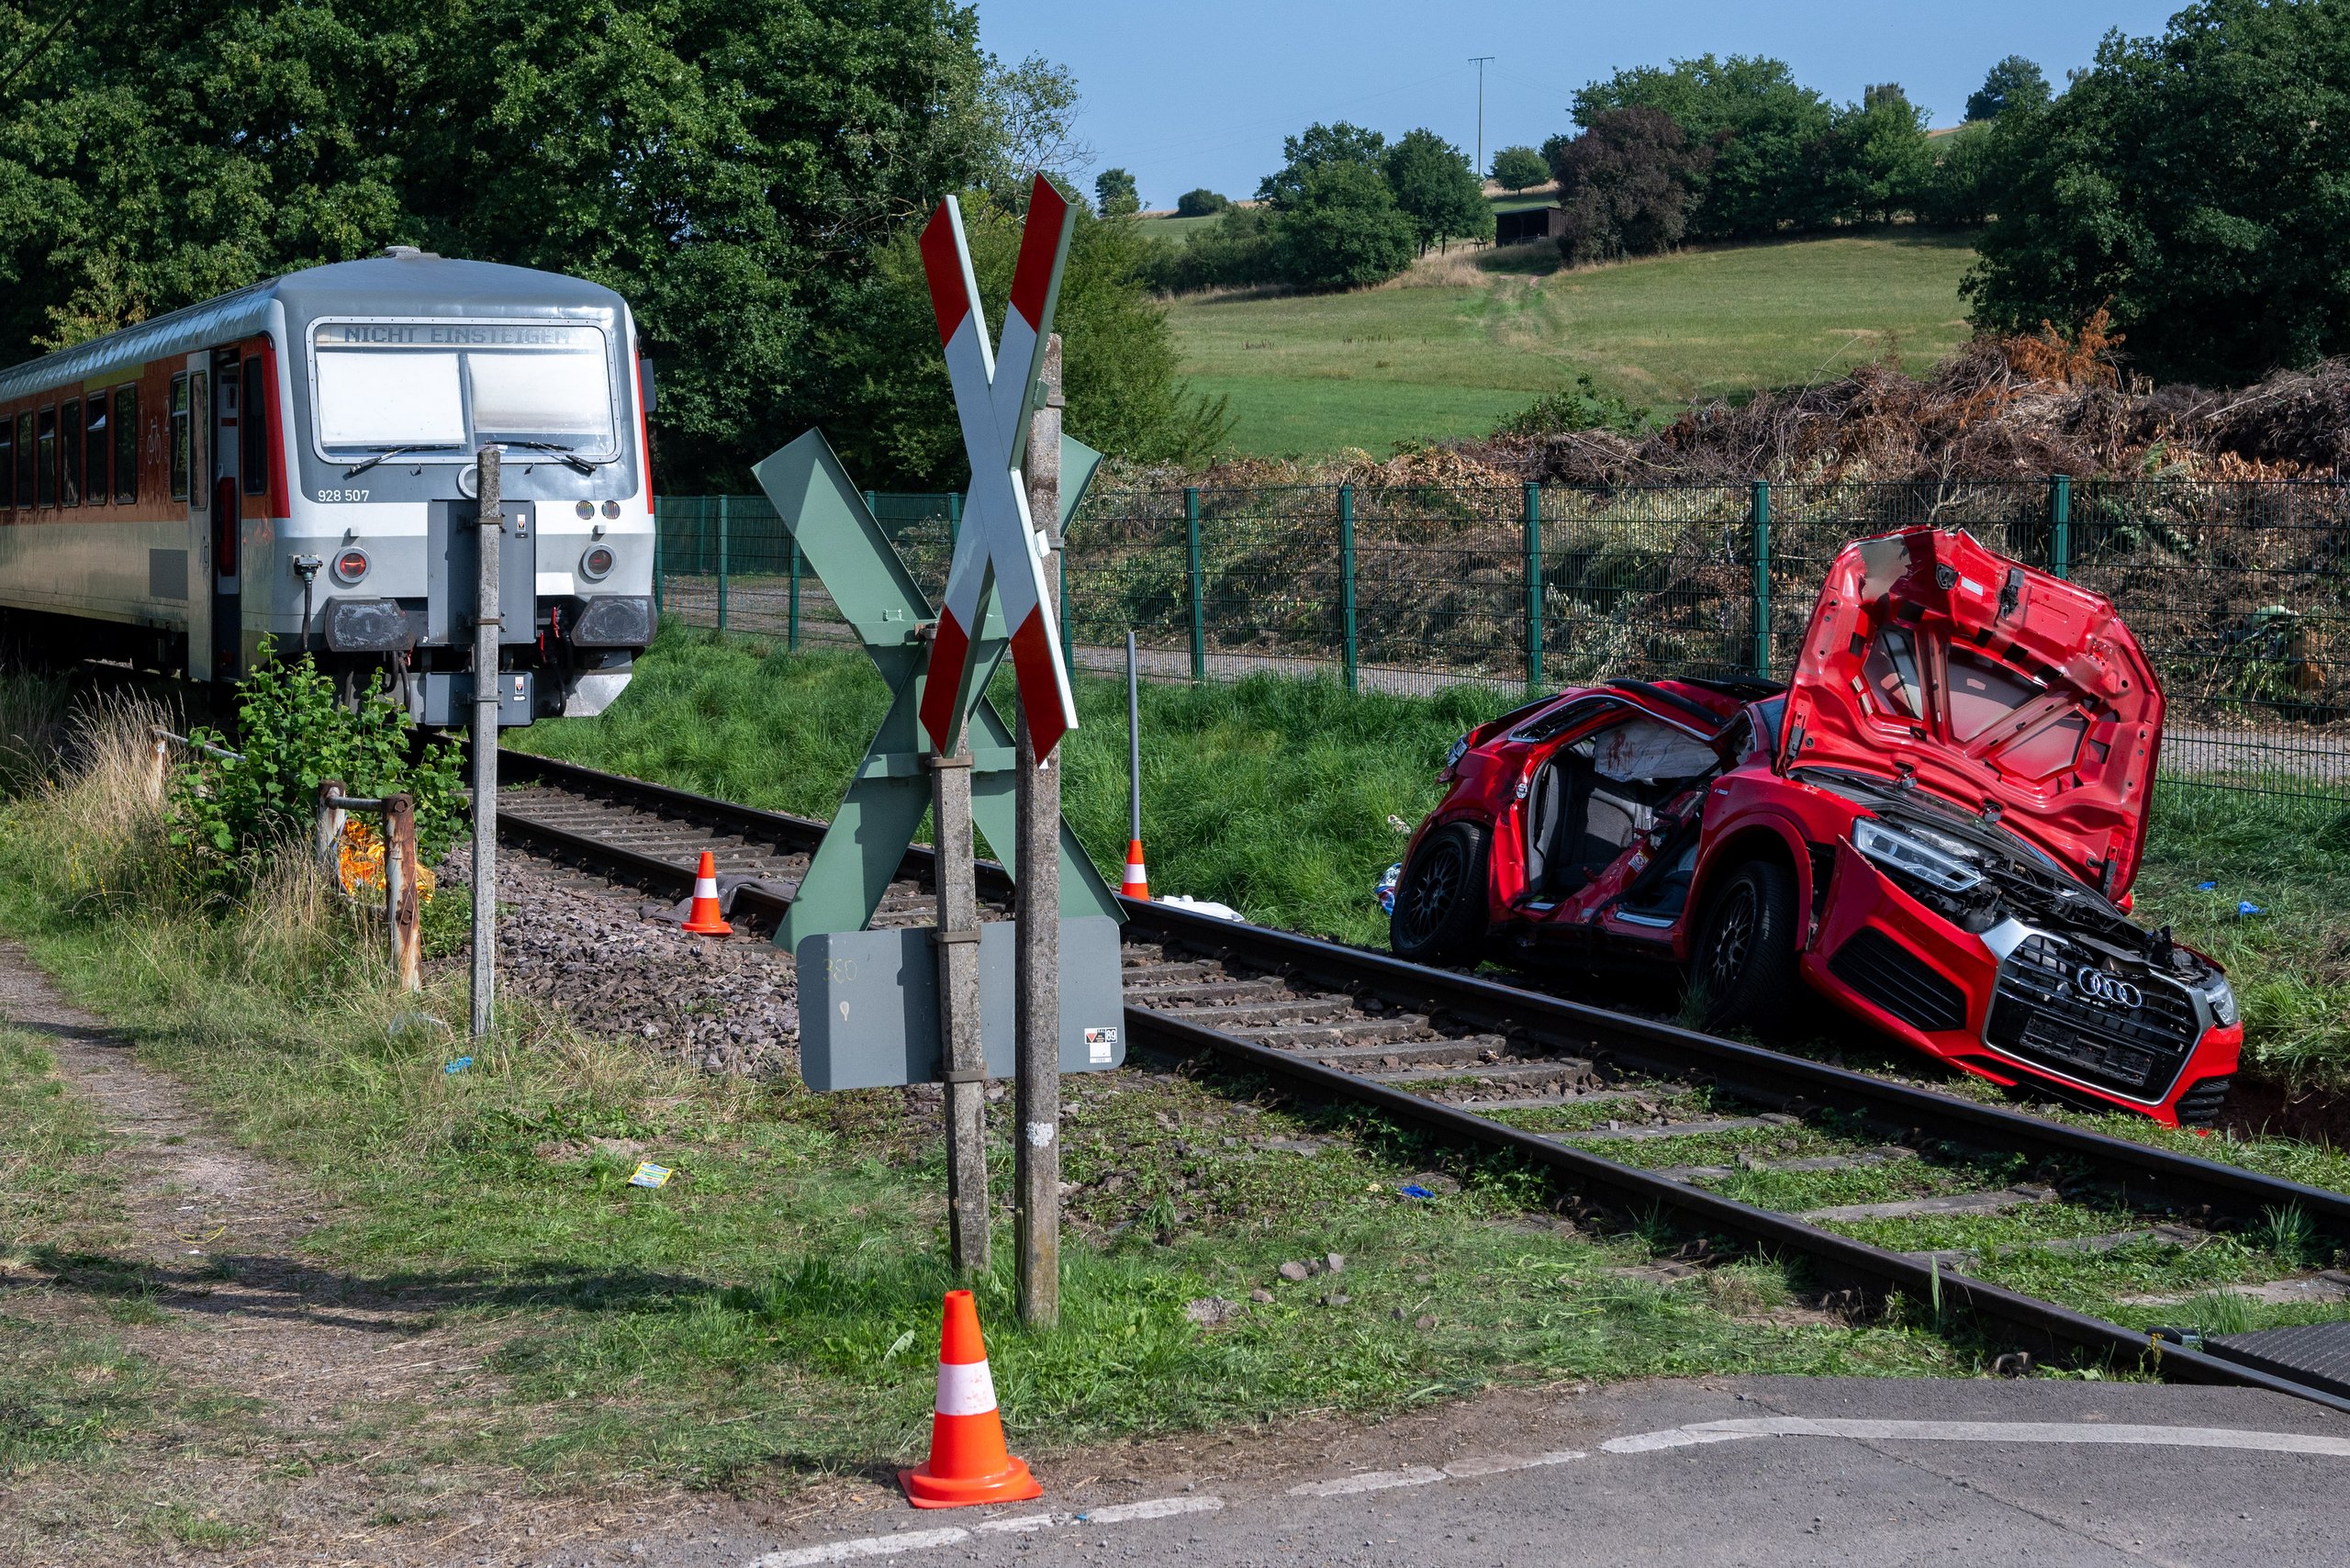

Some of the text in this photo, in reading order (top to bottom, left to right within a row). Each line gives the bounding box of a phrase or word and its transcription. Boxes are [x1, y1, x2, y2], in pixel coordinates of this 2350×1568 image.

[345, 327, 570, 344] NICHT EINSTEIGEN
[318, 489, 370, 502] 928 507
[1106, 1029, 1116, 1042] 89
